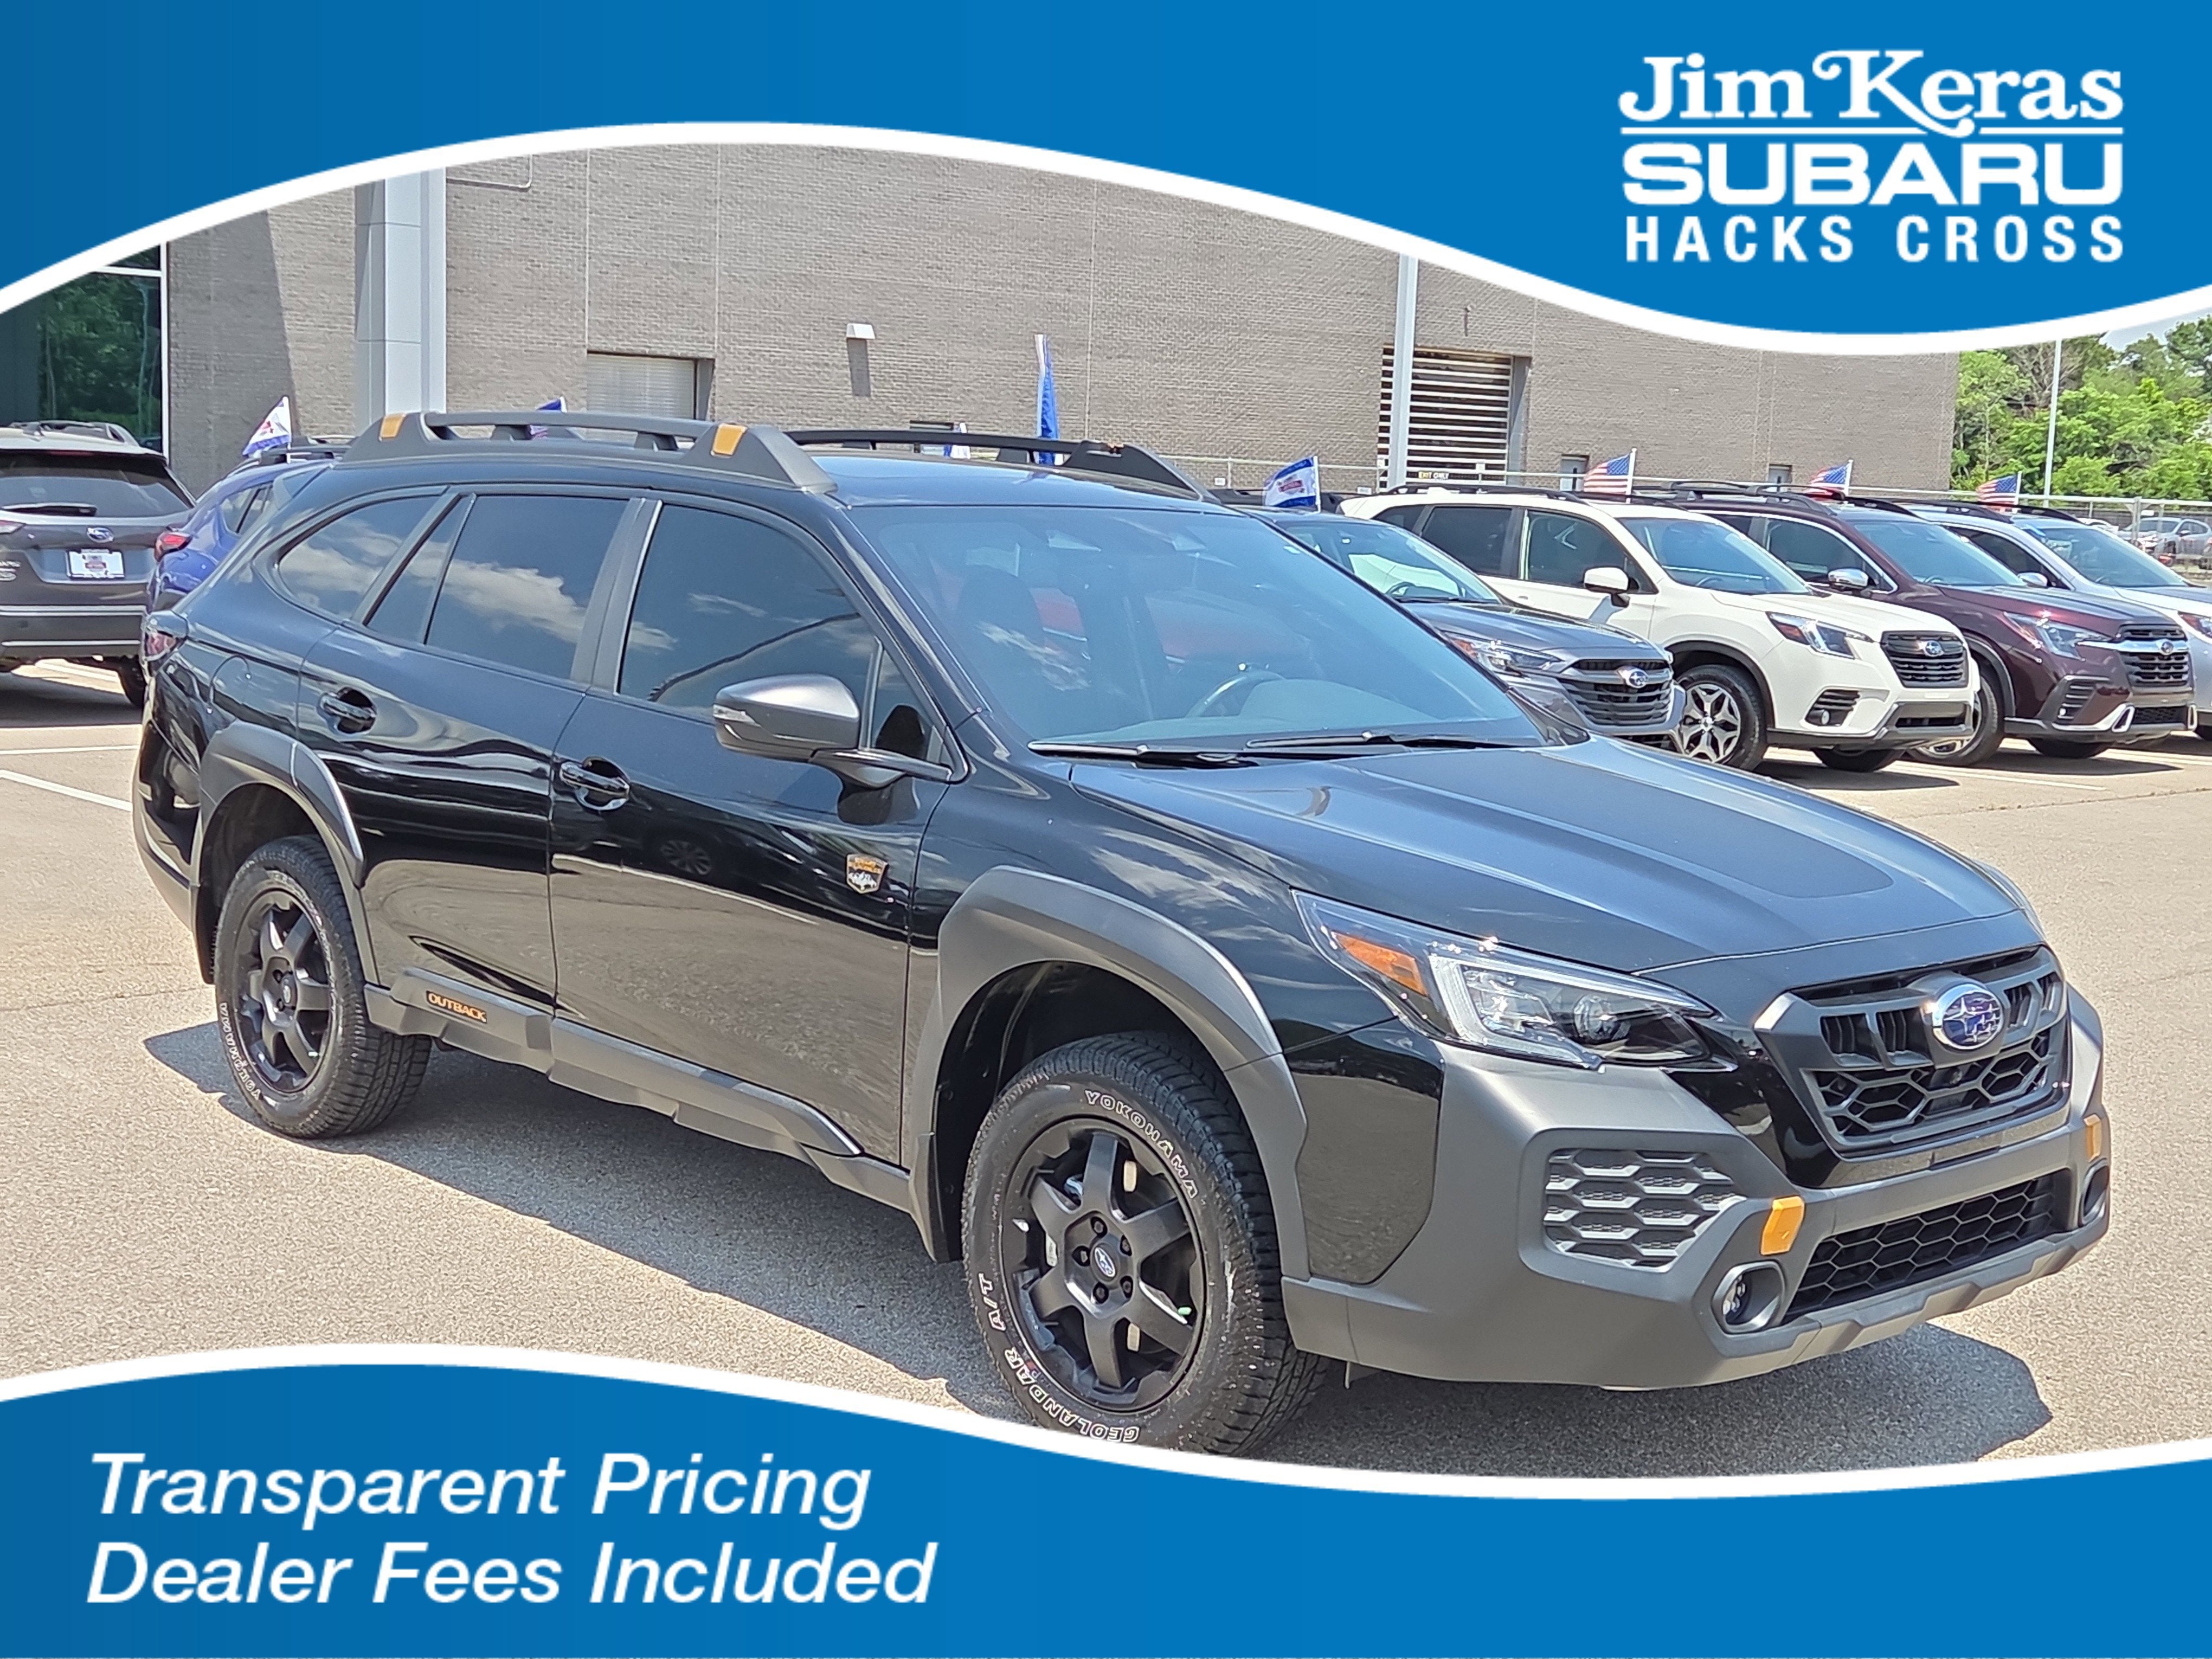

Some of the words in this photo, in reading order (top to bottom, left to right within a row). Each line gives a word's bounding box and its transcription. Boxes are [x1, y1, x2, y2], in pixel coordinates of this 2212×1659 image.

[428, 992, 487, 1023] OUTBACK
[1085, 1090, 1198, 1199] YOKOHAMA
[978, 1272, 1006, 1331] A/T
[1005, 1347, 1140, 1442] GEOLANDAR
